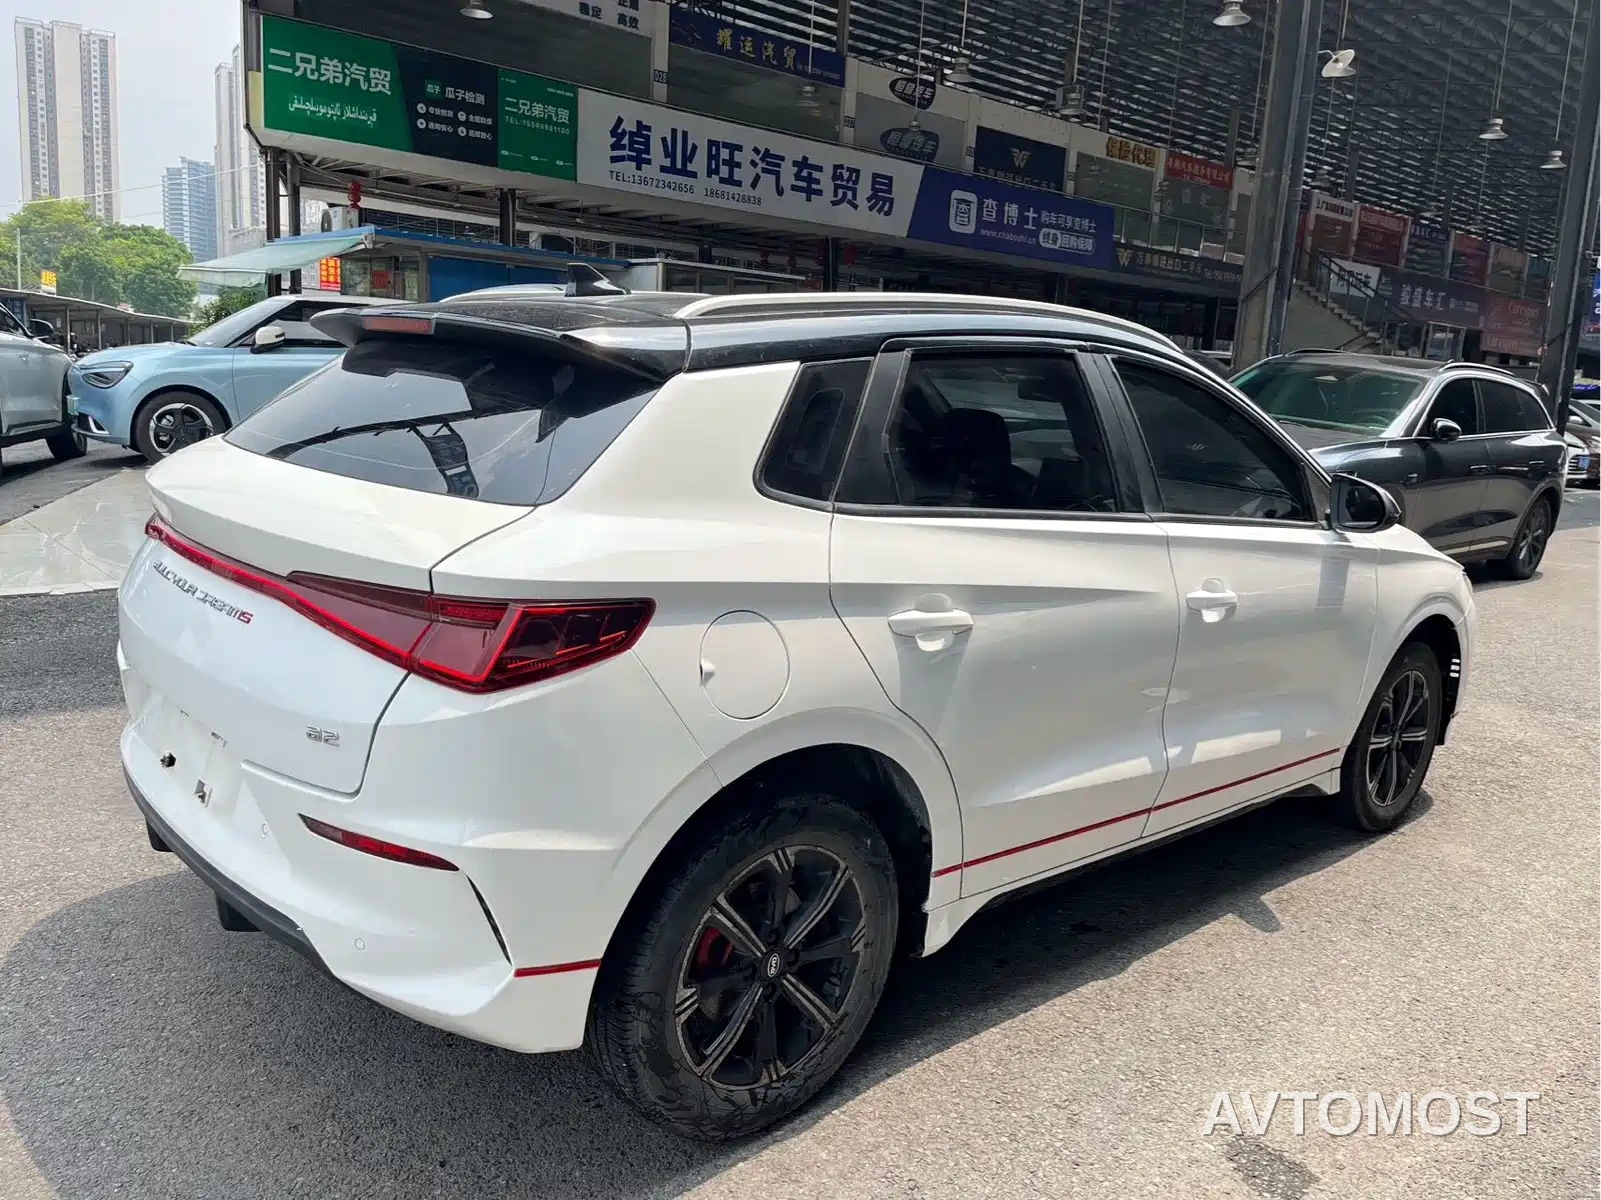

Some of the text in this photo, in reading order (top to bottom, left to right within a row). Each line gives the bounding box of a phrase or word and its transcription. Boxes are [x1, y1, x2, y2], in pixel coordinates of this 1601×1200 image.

[268, 48, 392, 95] 二兄弟汽贸
[445, 87, 486, 106] 瓜子检测
[505, 97, 570, 124] 二兄弟汽贸
[609, 115, 895, 217] 绰业旺汽车贸易
[609, 170, 695, 195] TEL:13672342656
[982, 198, 1038, 230] 查博士
